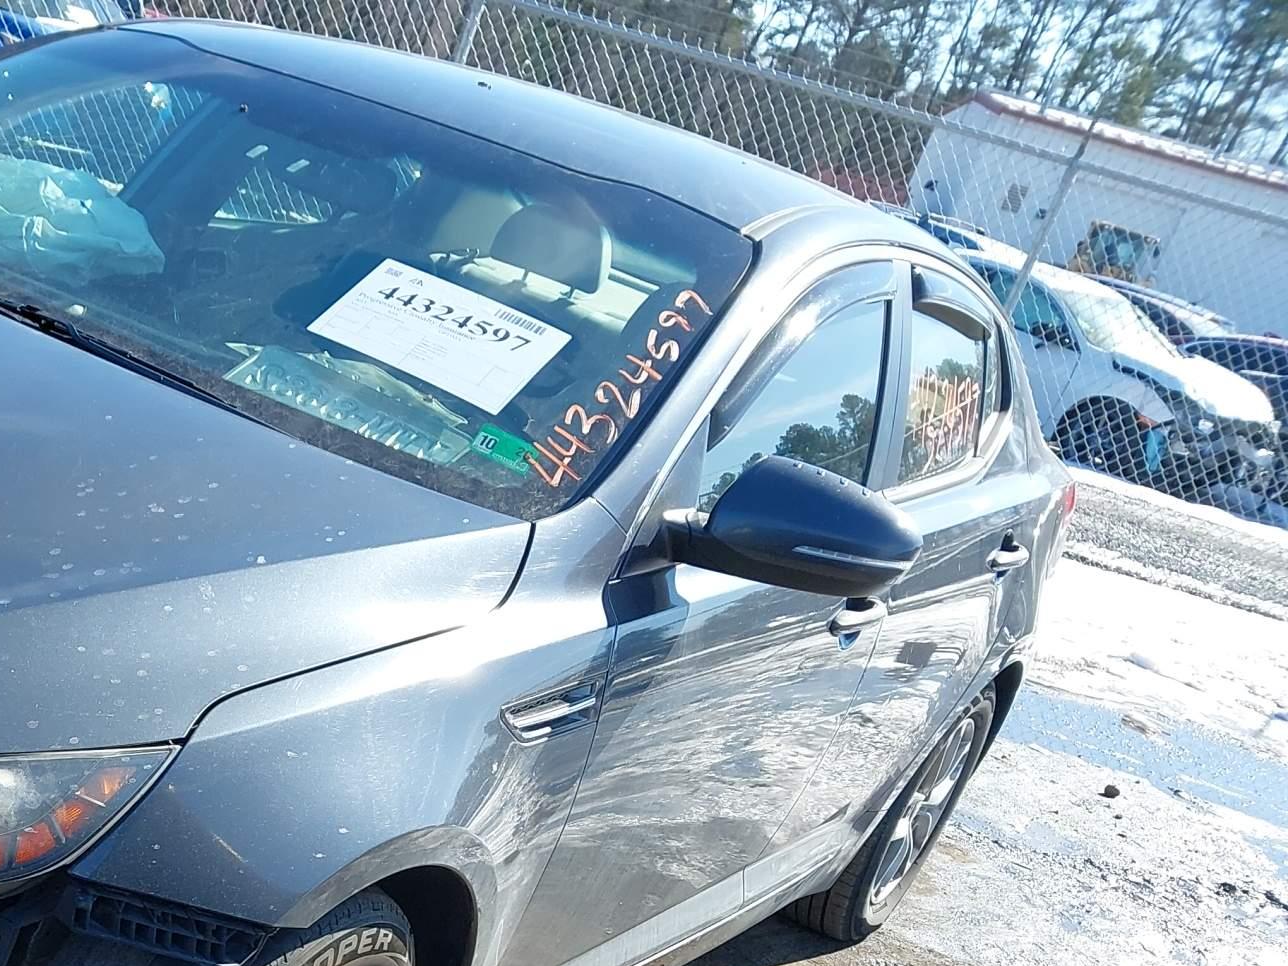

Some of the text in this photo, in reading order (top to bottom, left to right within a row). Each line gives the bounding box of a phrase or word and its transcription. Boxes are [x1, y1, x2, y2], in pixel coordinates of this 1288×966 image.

[377, 285, 532, 352] 44324597
[524, 288, 714, 488] 44324597
[479, 434, 498, 450] 10
